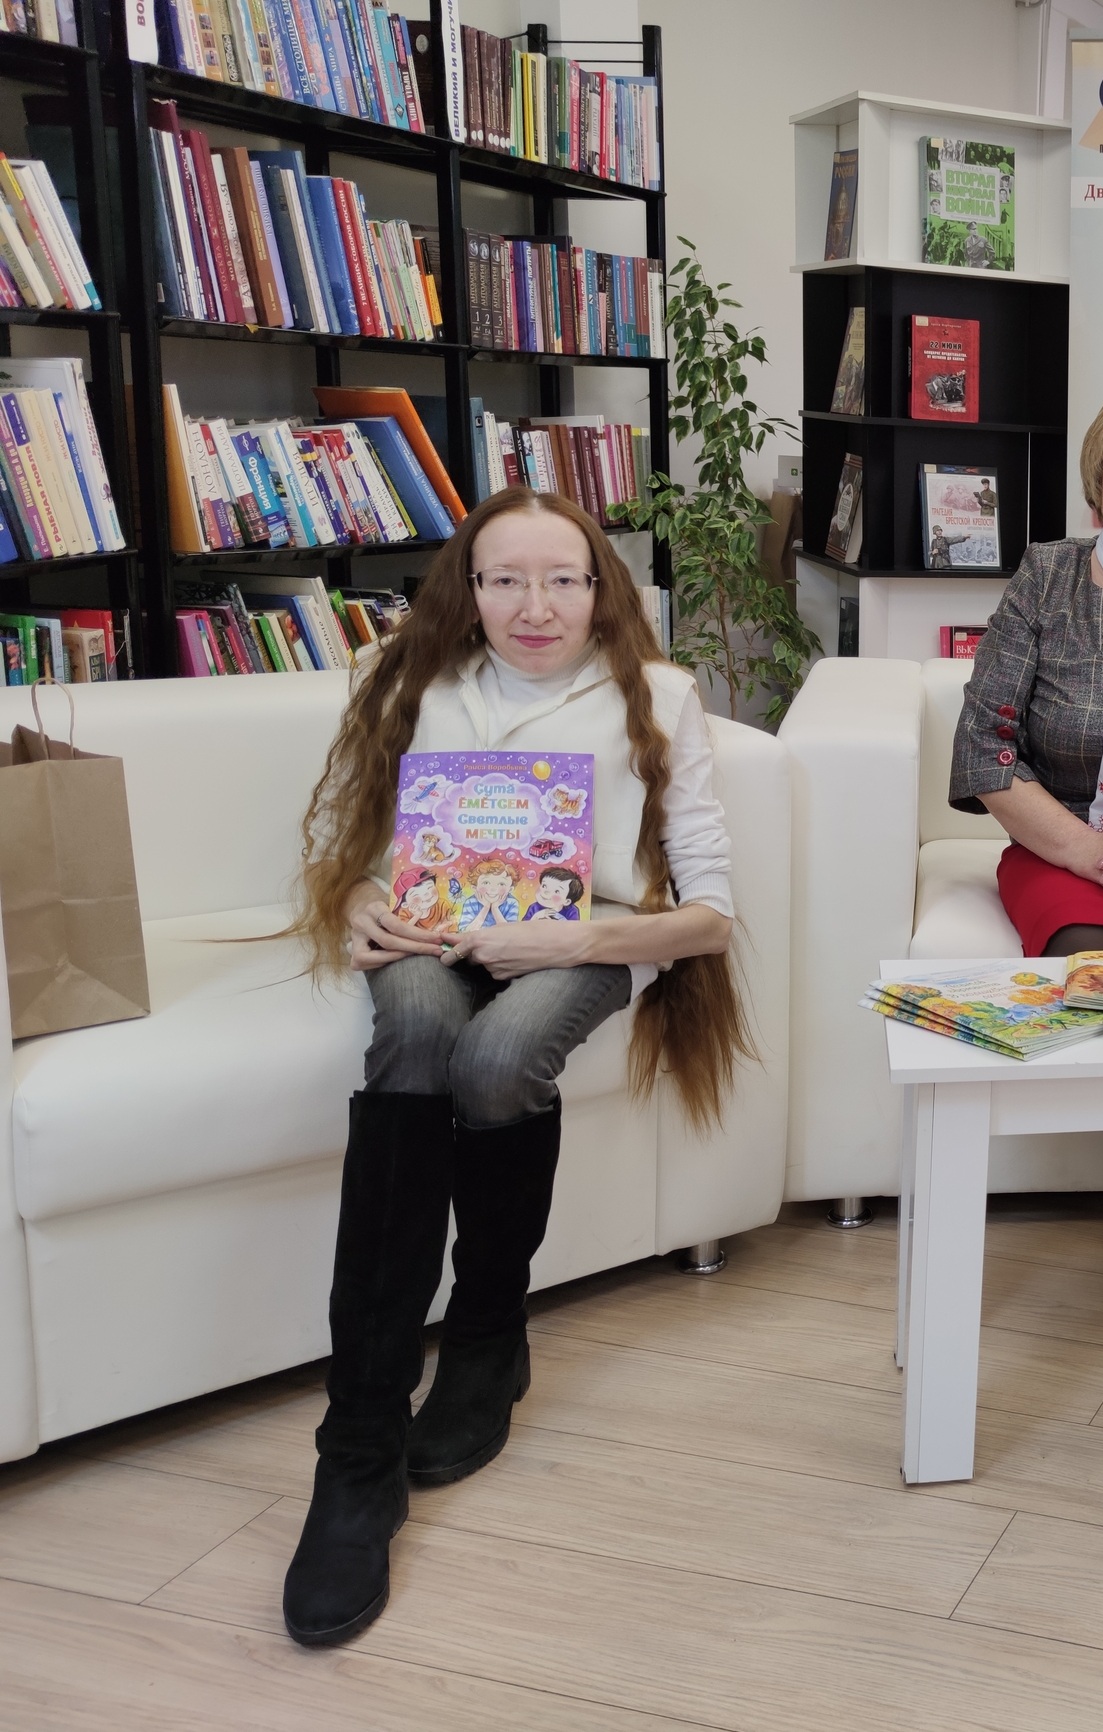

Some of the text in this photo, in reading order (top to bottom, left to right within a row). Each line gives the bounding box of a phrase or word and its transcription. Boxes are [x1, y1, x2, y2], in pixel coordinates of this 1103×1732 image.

[285, 18, 304, 72] СТОЛИЦЫ
[450, 57, 457, 67] И
[299, 74, 310, 94] ВСЕ
[327, 47, 346, 110] СТРАНЫ МИРА
[402, 71, 417, 121] ГОРОДА МИРА
[449, 71, 461, 137] ВЕЛИКИЙ
[578, 85, 587, 159] РУССКАЯ КУЛЬТУРА
[591, 107, 599, 136] ЦИТАТЫ
[176, 133, 199, 221] КРАСАВИЦА МОСКВА
[946, 170, 995, 189] ВТОРАЯ
[946, 184, 995, 201] МИРОВАЯ
[219, 182, 242, 255] МОСКОВСКАЯ
[338, 189, 350, 223] РОССИИ
[946, 196, 996, 217] ВОЙНА
[199, 172, 229, 291] МОСКВА MOSCOW
[345, 224, 358, 261] СОБОРОВ
[217, 218, 236, 281] МОЙ РОДНОЙ
[361, 245, 371, 277] РОССИИ
[353, 261, 366, 300] ВЕЛИКИХ
[478, 263, 486, 305] АНТОЛОГИЯ
[475, 311, 479, 321] 1
[484, 313, 490, 324] 2
[498, 315, 502, 325] 3
[611, 325, 615, 333] 4
[930, 341, 962, 350] 22 ИЮНЯ
[191, 430, 217, 495] ЛОНДОН
[216, 423, 245, 492] ШОТЛАНДИЯ
[24, 444, 61, 543] РЫБНАЯ ЛОВЛЯ
[246, 455, 271, 510] Франция
[292, 449, 318, 507] ИТАЛИЯ
[420, 477, 439, 508] УКРАИНА
[218, 502, 228, 525] МОРТОН
[373, 486, 393, 519] ИЗРАИЛЬ
[380, 487, 397, 515] КИТАЙ
[932, 508, 953, 516] ТРАГЕДИЯ
[946, 516, 994, 527] БРЕСТСКОЙ КРЕПОСТИ
[266, 629, 278, 653] ИСТОРИЯ
[458, 814, 528, 825] Светлые
[466, 829, 520, 839] МЕЧТЫ
